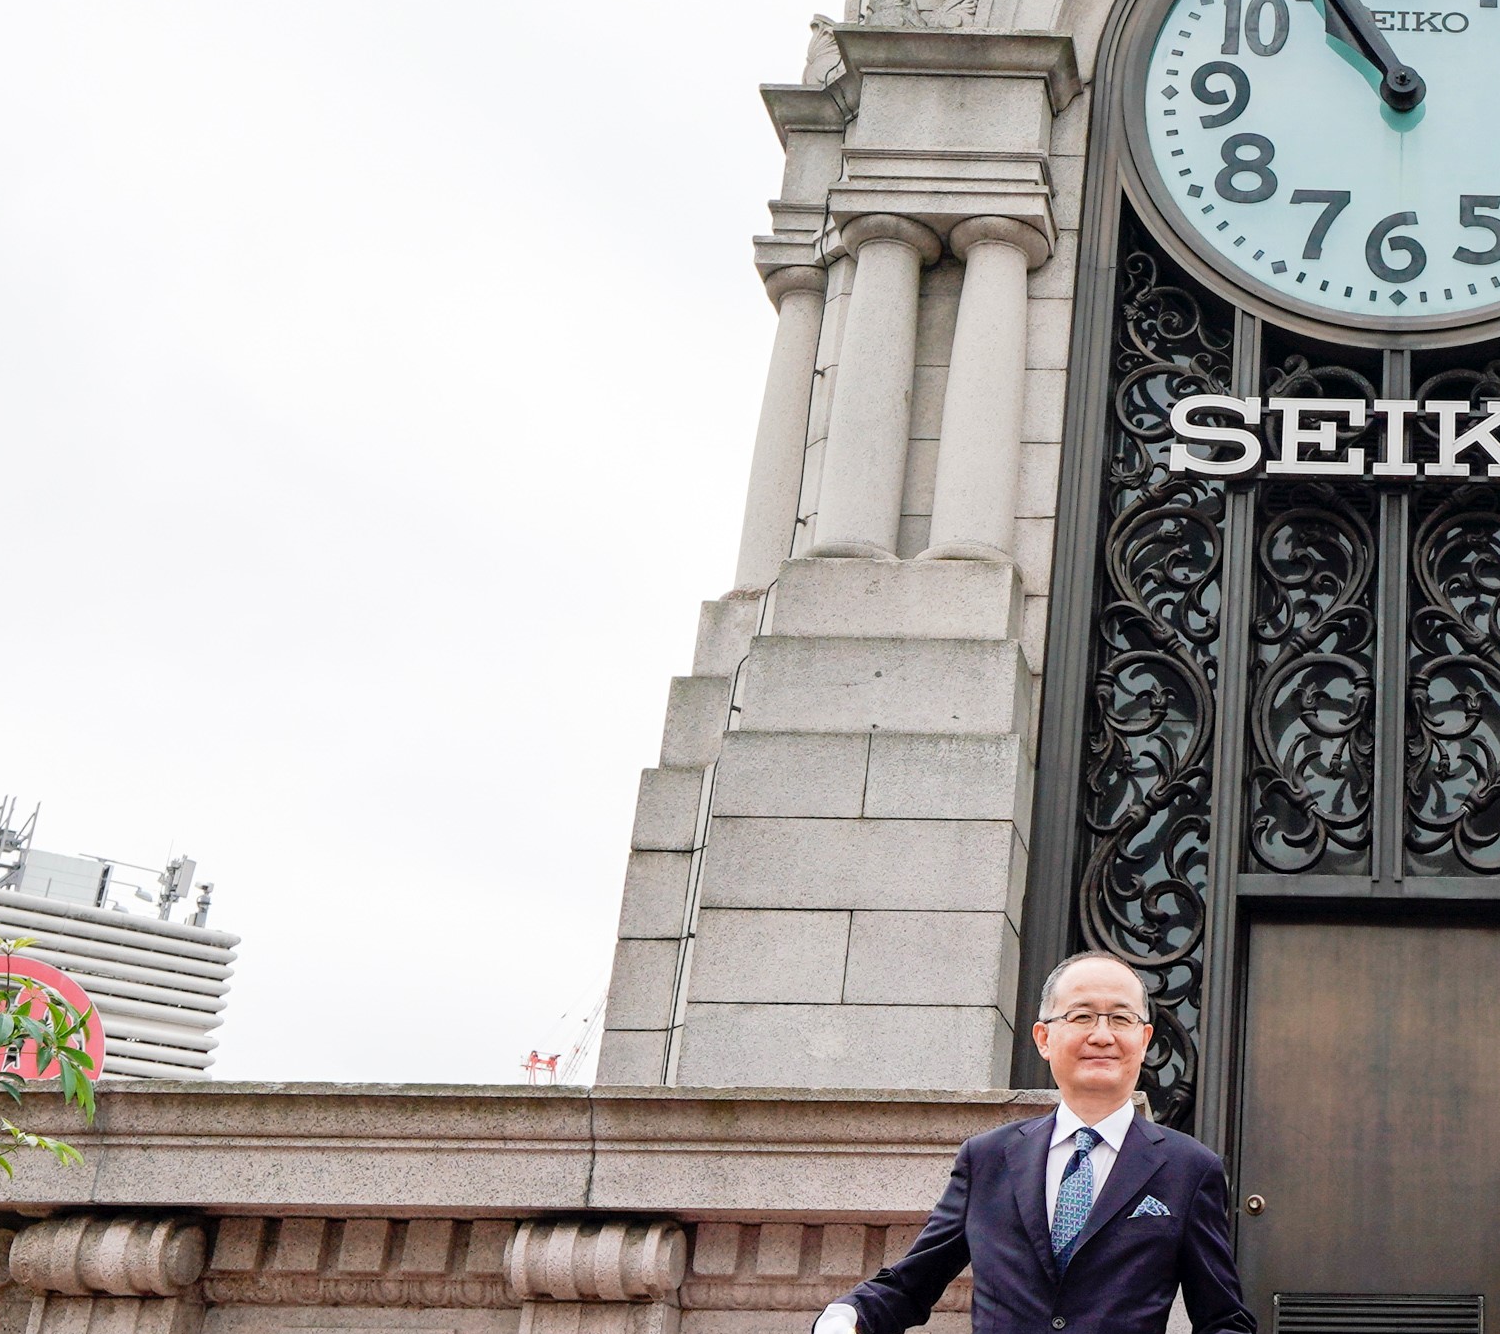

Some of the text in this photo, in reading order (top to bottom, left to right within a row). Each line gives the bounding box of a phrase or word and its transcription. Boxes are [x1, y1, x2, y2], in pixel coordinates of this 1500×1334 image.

[1365, 7, 1470, 34] EIKO
[1190, 61, 1251, 129] 9
[1214, 133, 1278, 204] 8
[1289, 190, 1352, 260] 7
[1365, 211, 1427, 283] 6
